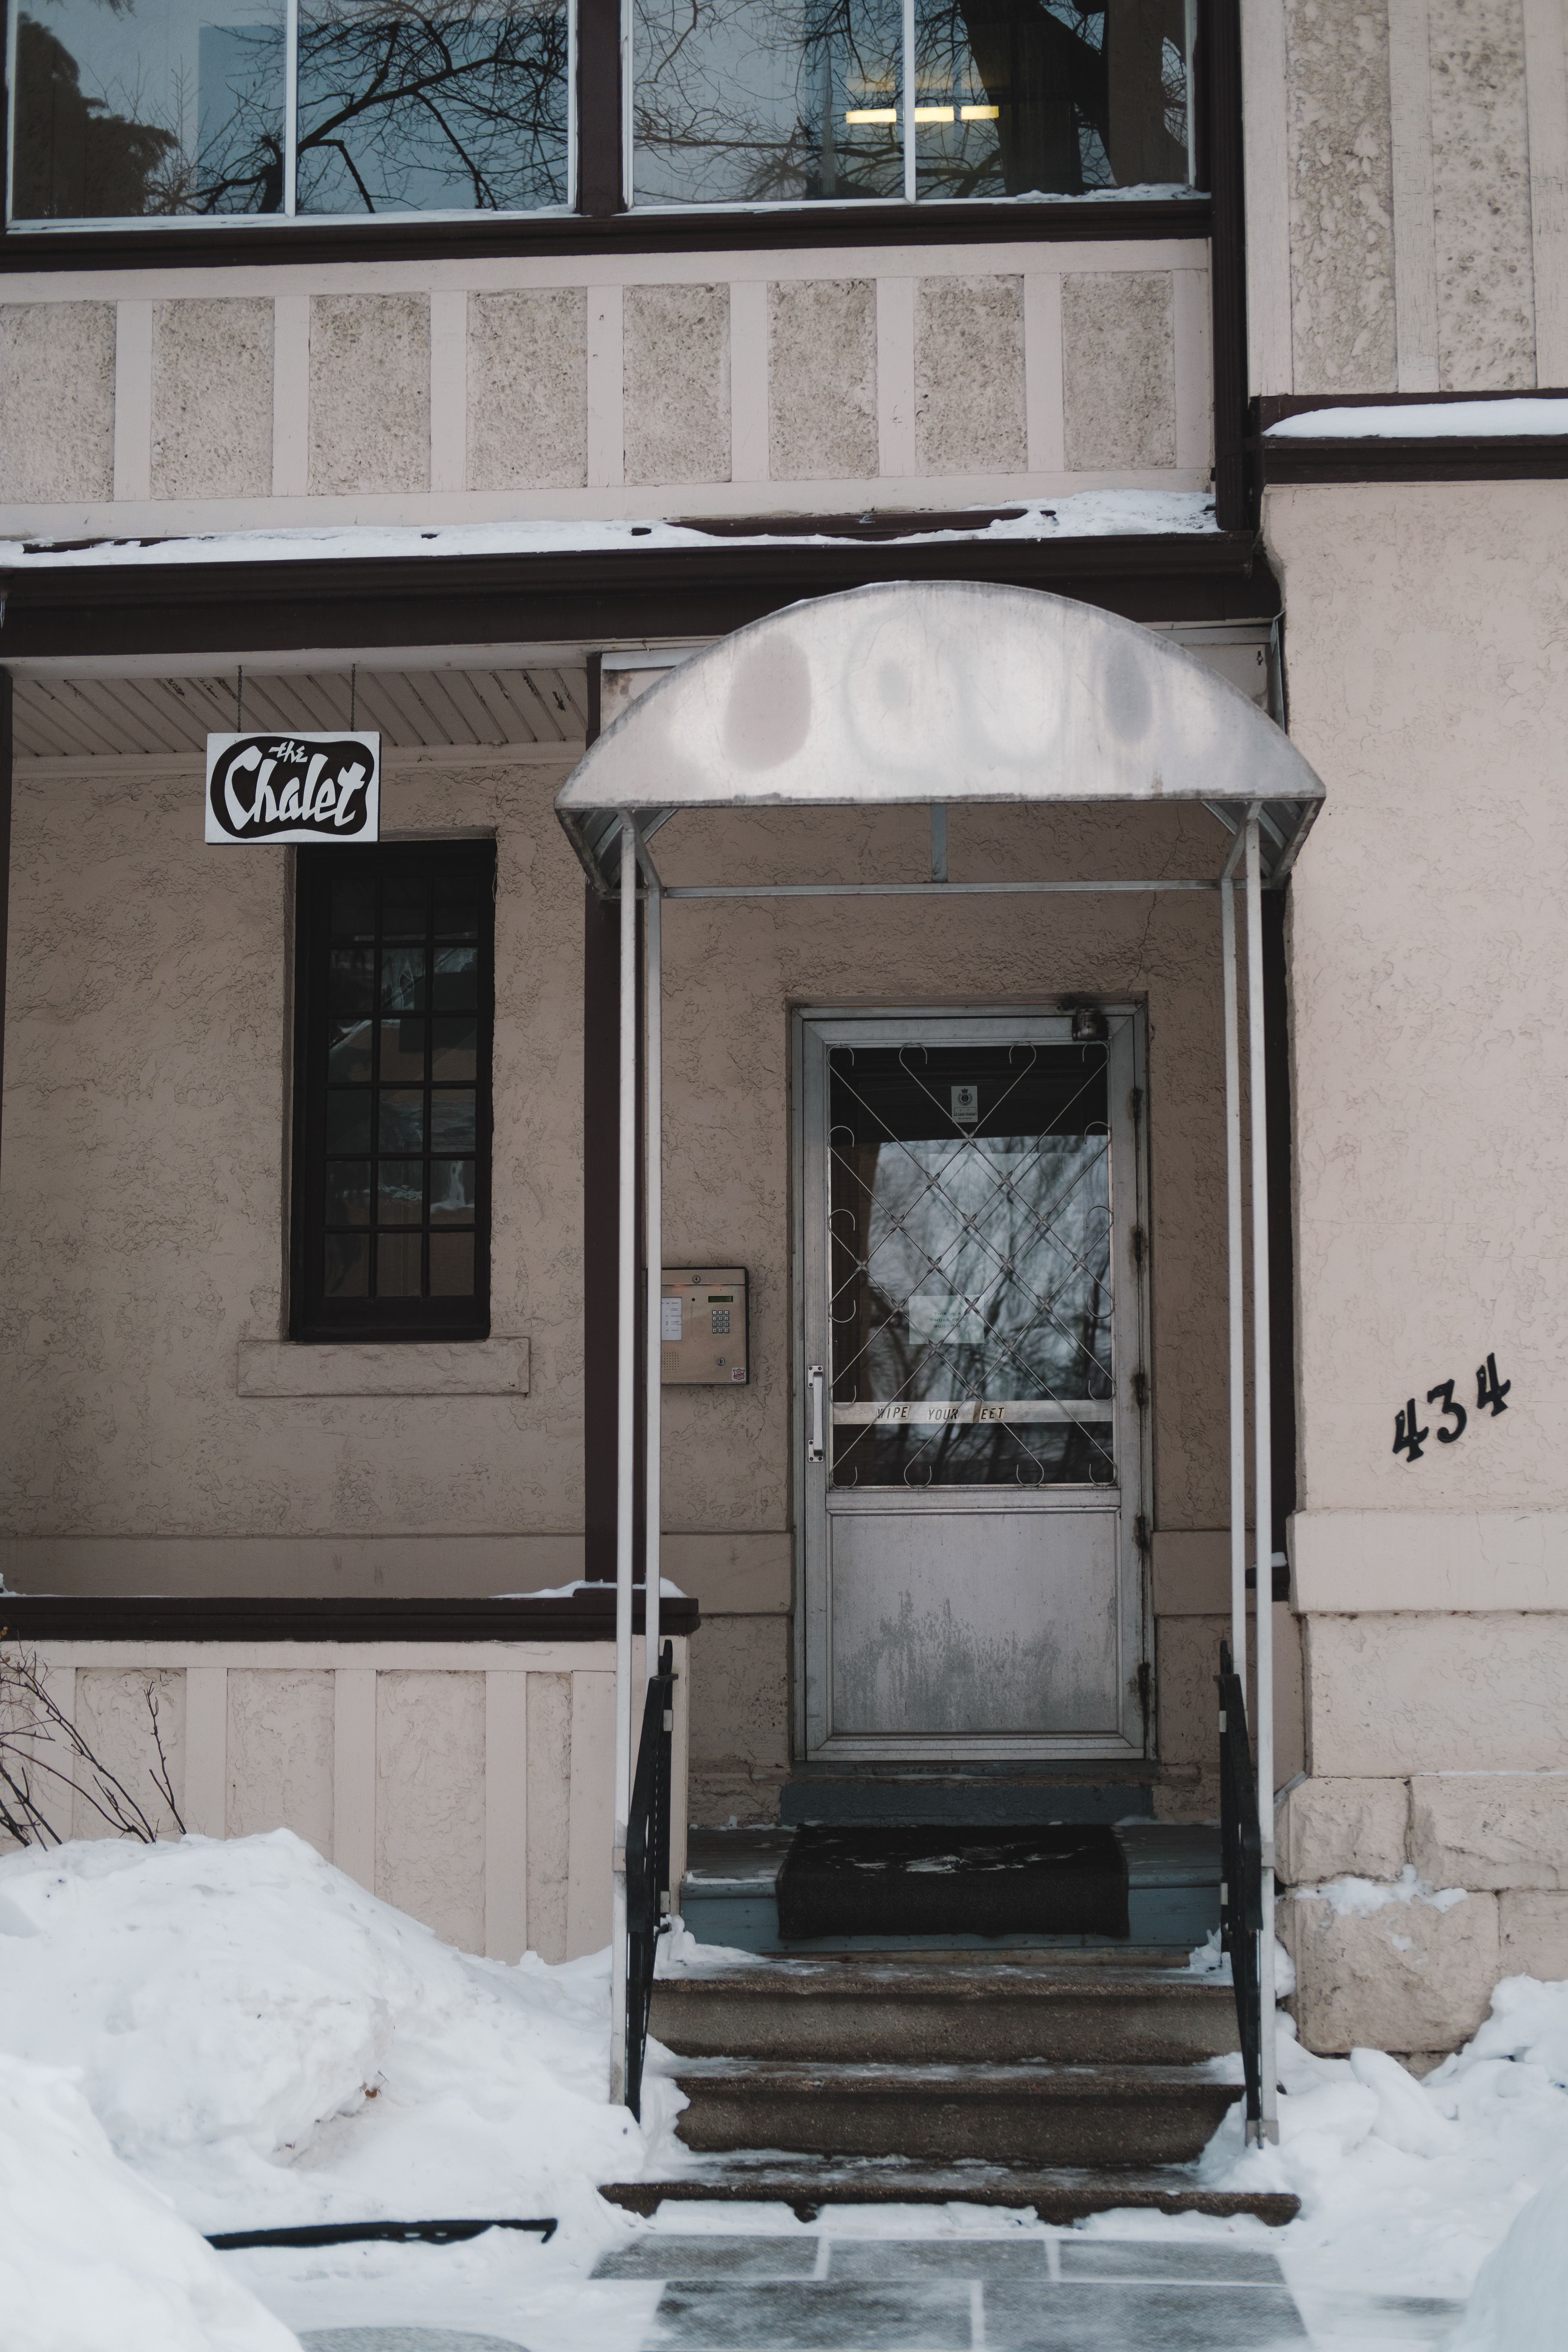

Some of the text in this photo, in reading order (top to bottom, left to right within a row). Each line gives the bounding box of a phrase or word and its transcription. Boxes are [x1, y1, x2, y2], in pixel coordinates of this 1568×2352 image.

[268, 740, 308, 763] the
[224, 745, 366, 830] Chalet
[878, 1407, 908, 1419] WIPE
[929, 1408, 958, 1420] YOUR
[1392, 1352, 1511, 1463] 434
